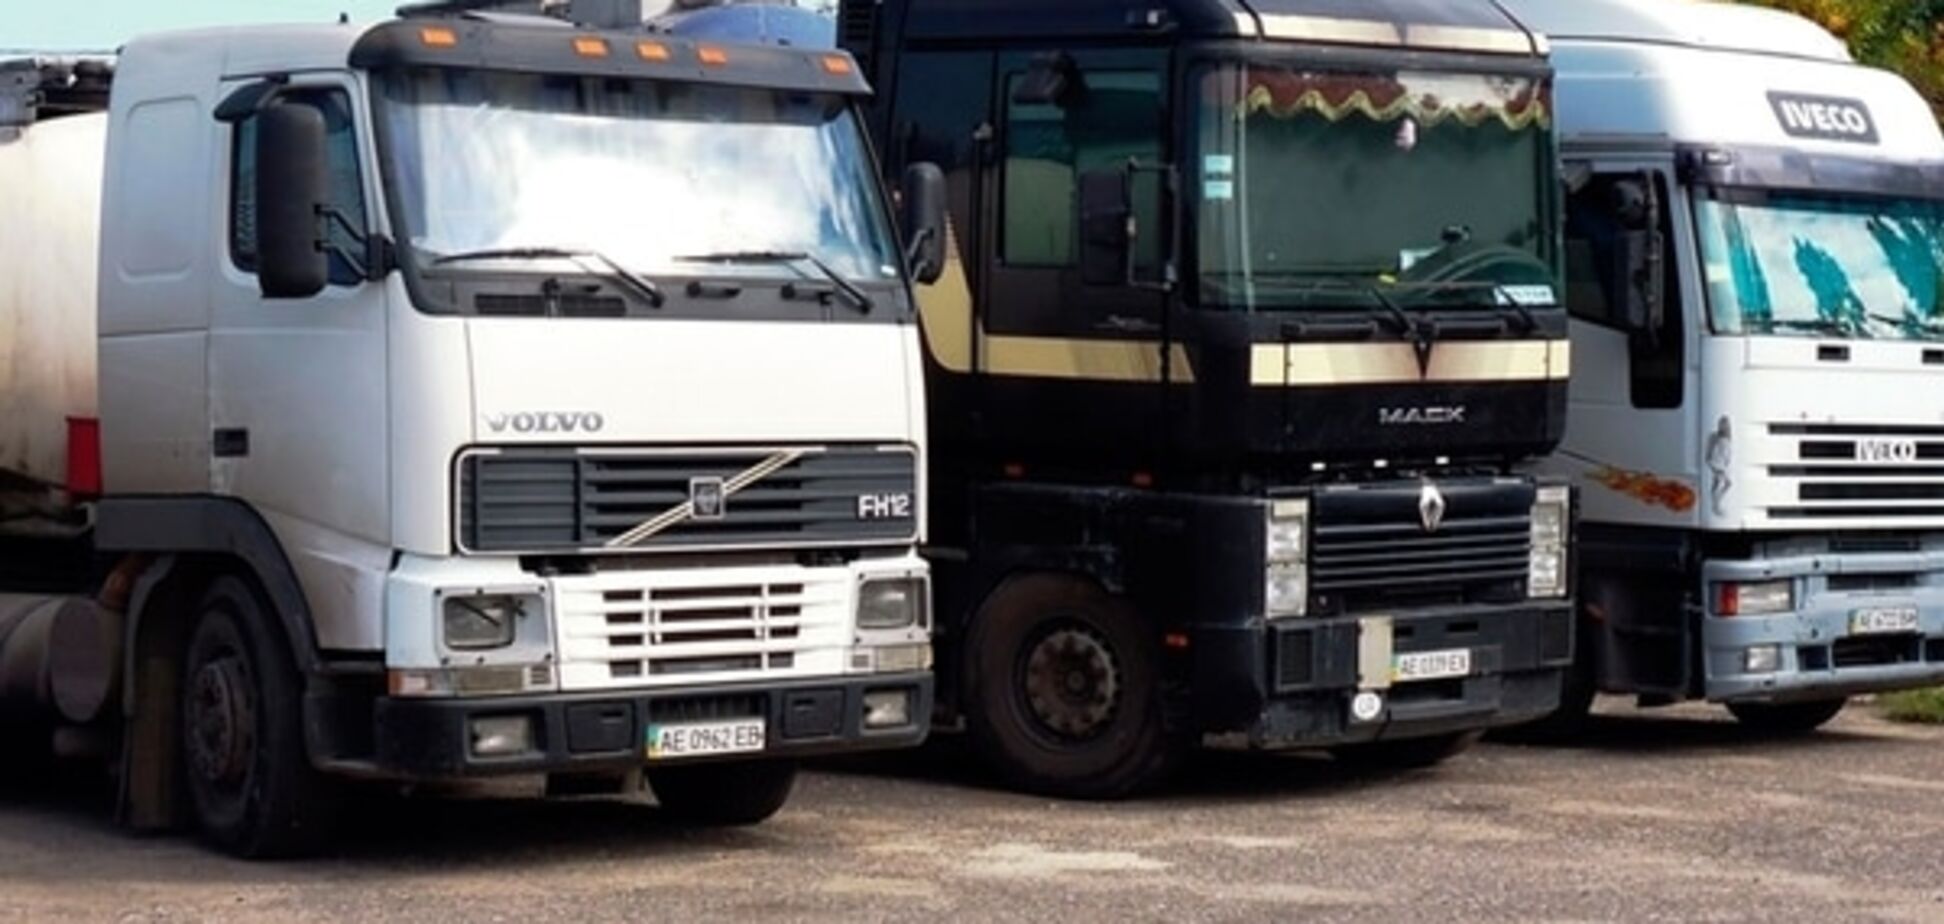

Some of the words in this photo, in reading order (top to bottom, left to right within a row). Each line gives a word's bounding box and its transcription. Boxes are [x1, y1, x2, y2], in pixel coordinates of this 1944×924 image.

[1780, 100, 1867, 134] IVECO
[481, 411, 604, 433] VOLVO
[1379, 407, 1465, 423] MACK
[859, 493, 909, 518] FH12
[660, 729, 686, 752] AE
[690, 727, 730, 750] 0962
[735, 725, 760, 747] EB
